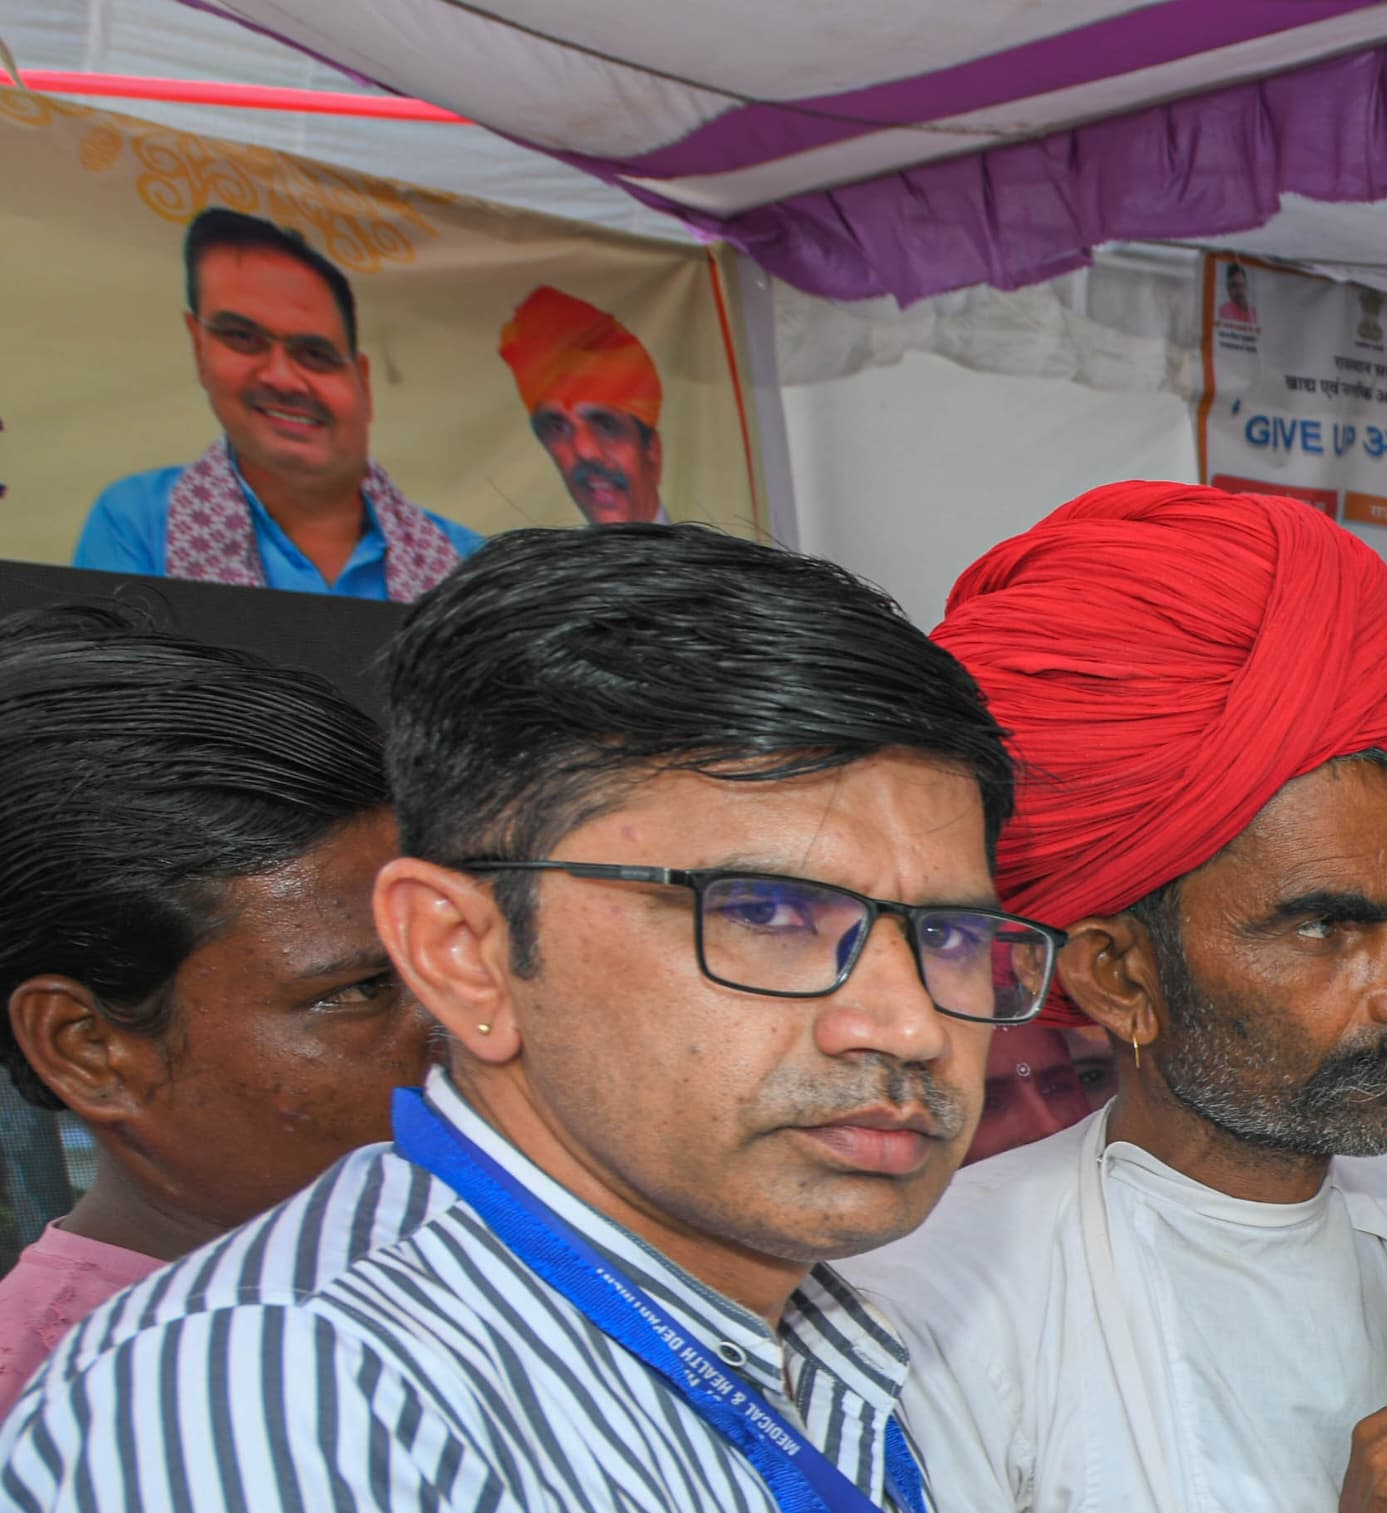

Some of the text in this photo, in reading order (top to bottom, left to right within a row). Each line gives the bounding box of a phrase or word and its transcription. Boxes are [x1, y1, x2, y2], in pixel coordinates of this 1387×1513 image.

[1284, 374, 1316, 393] खाद्य
[680, 1347, 736, 1394] HEALTH
[730, 1391, 747, 1406] &
[745, 1402, 801, 1456] MEDICAL
